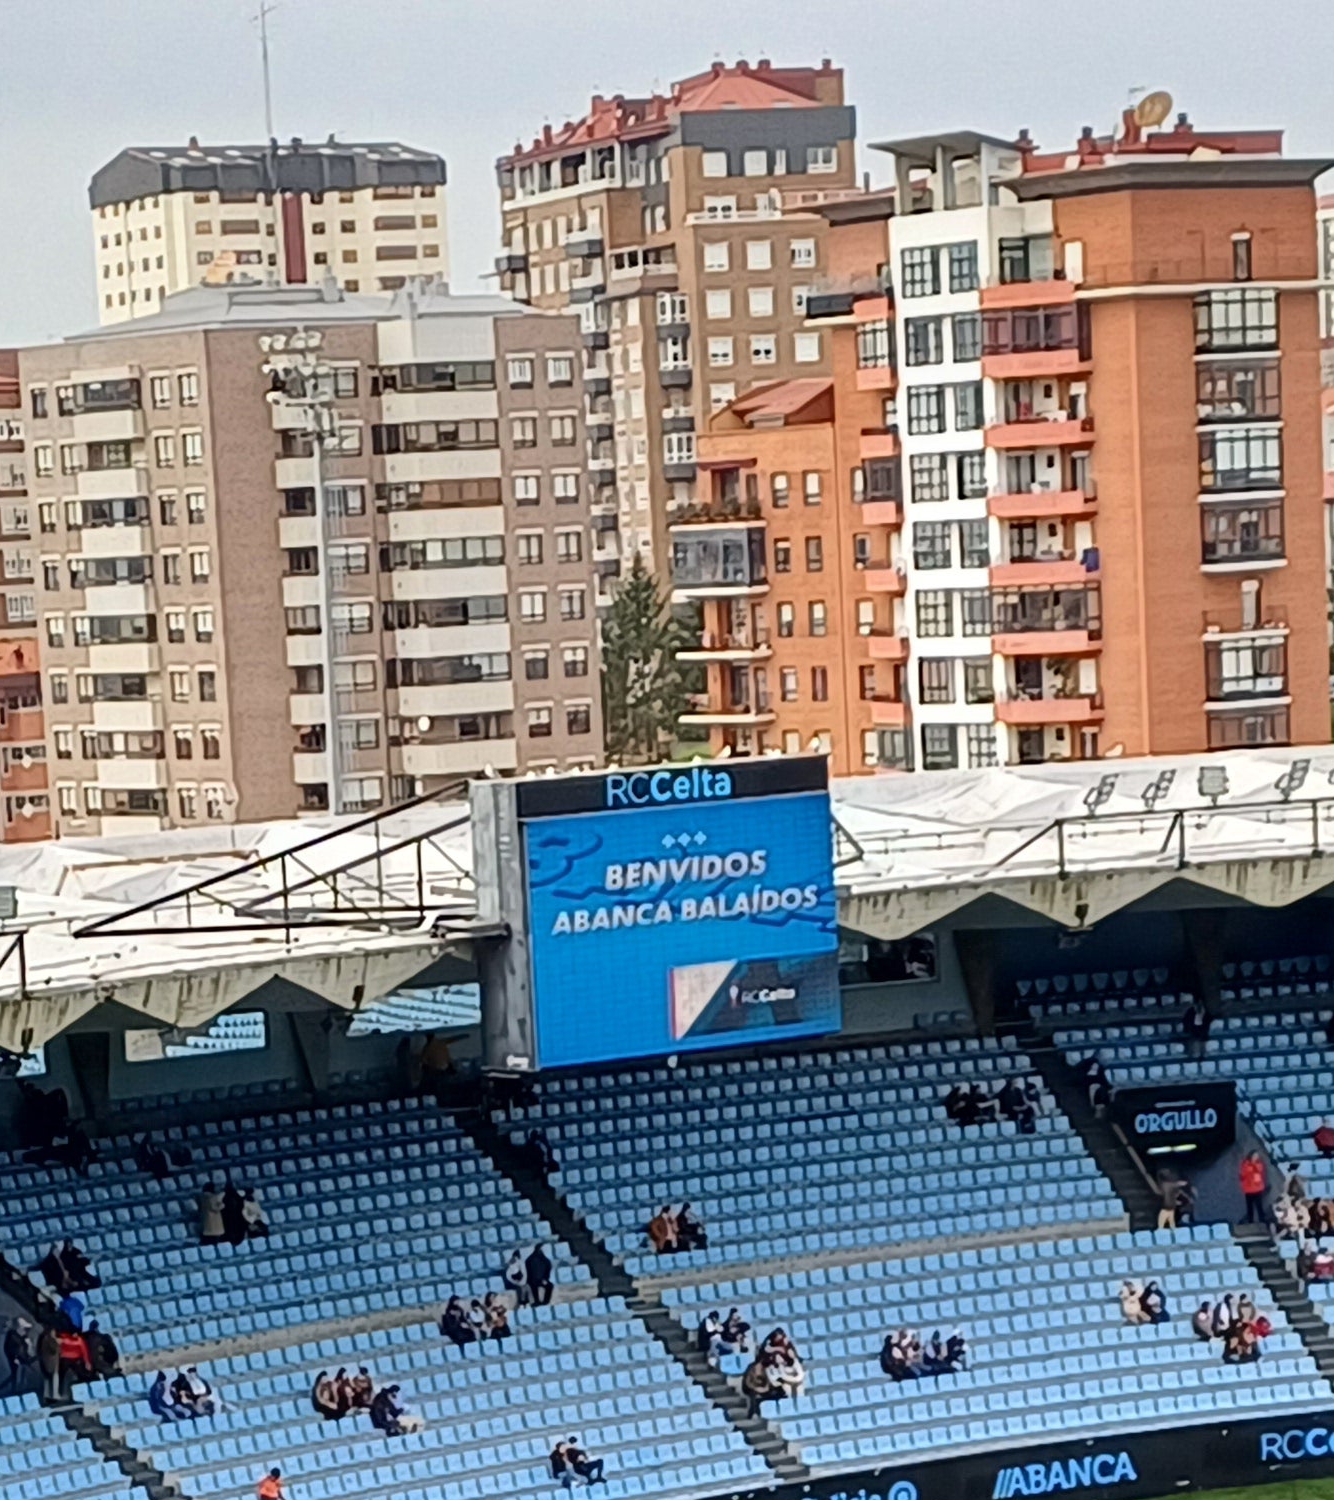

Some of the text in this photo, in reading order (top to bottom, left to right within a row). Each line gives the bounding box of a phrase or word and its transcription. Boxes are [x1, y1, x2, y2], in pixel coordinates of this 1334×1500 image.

[607, 768, 731, 807] RCCelta
[605, 851, 766, 891] BENVIDOS
[552, 884, 817, 936] ABANCA BALAÍDOS
[1134, 1108, 1217, 1133] ORGULLO
[992, 1452, 1137, 1499] ABANCA
